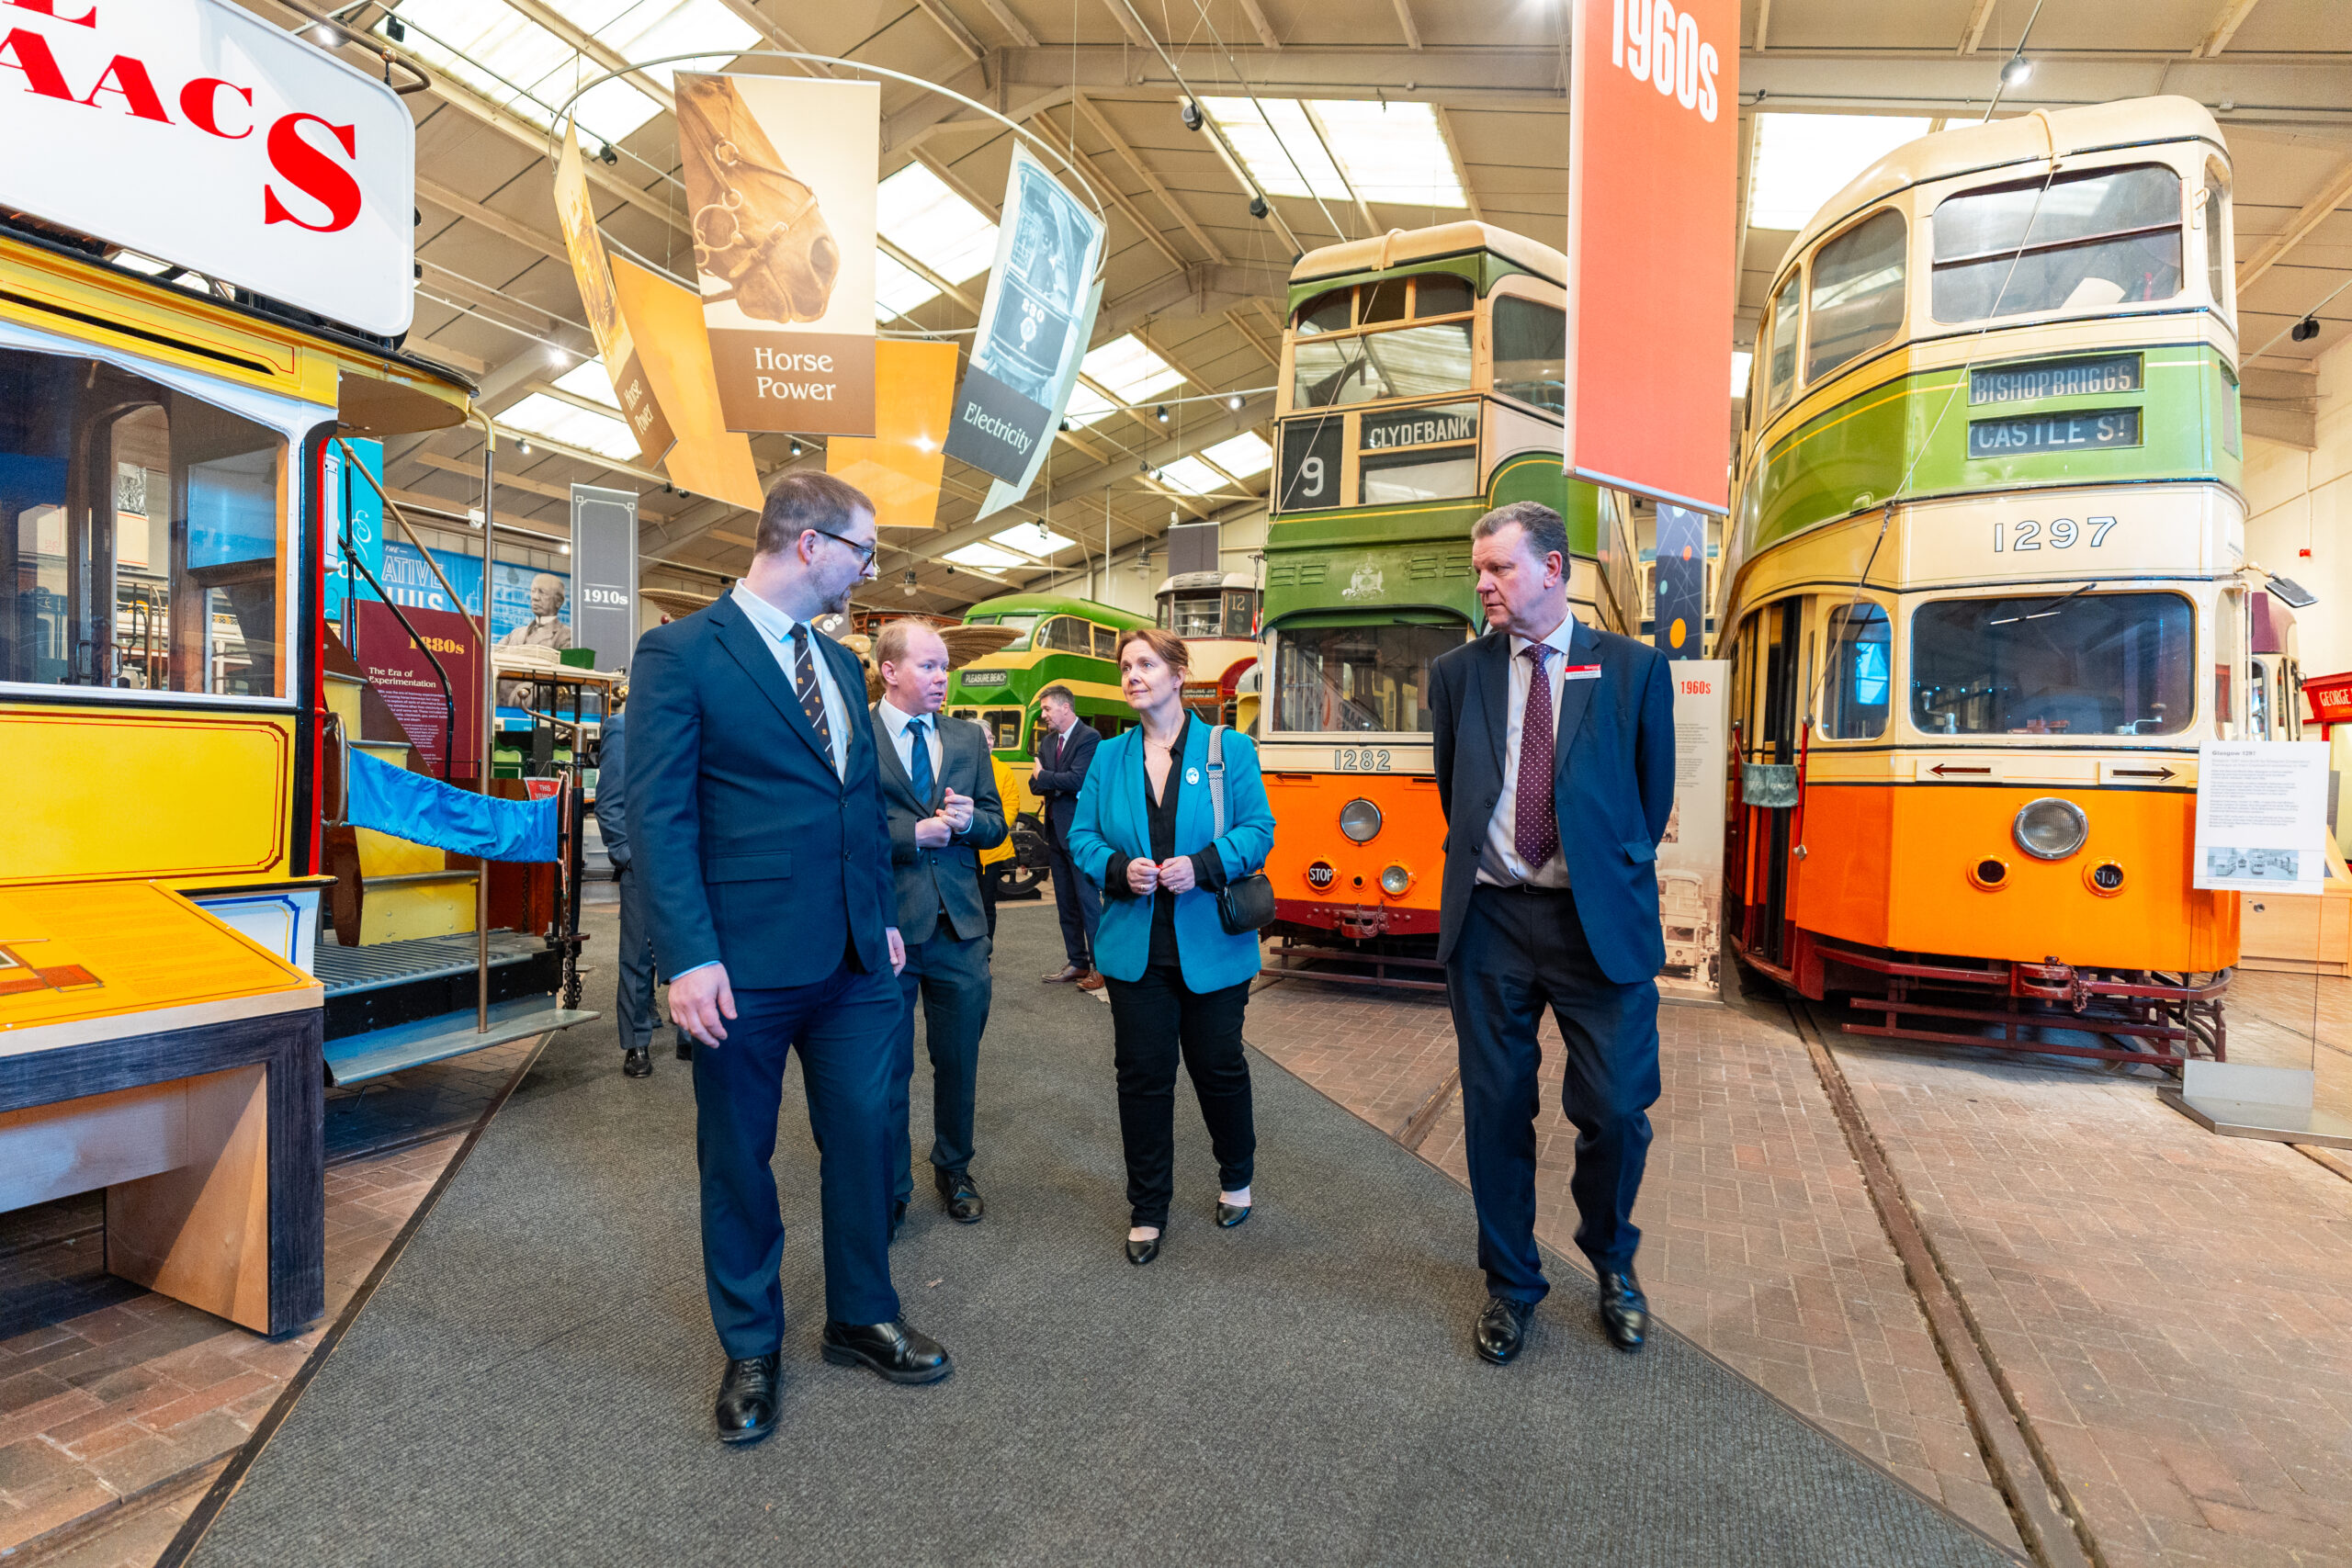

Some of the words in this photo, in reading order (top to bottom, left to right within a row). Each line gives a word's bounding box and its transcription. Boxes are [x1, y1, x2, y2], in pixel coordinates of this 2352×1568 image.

[1612, 0, 1718, 123] 1960s
[754, 346, 833, 373] Horse
[757, 376, 836, 401] Power
[1974, 366, 2132, 404] BISHOPBRIGGS
[963, 401, 1033, 456] Electricity
[1370, 416, 1471, 449] CLYDEBANK
[1978, 418, 2086, 448] CASTLE
[1301, 457, 1325, 497] 9
[1994, 515, 2117, 552] 1297
[384, 545, 399, 553] THE
[583, 588, 628, 606] 1910s
[1231, 594, 1246, 611] 12
[368, 667, 385, 675] The
[388, 669, 401, 677] Era
[368, 675, 436, 688] Experimentation
[966, 673, 990, 683] PLEASURE
[1680, 681, 1712, 694] 1960s
[2319, 689, 2351, 706] GEORGE
[1334, 749, 1391, 772] 1282
[1308, 867, 1334, 883] STOP
